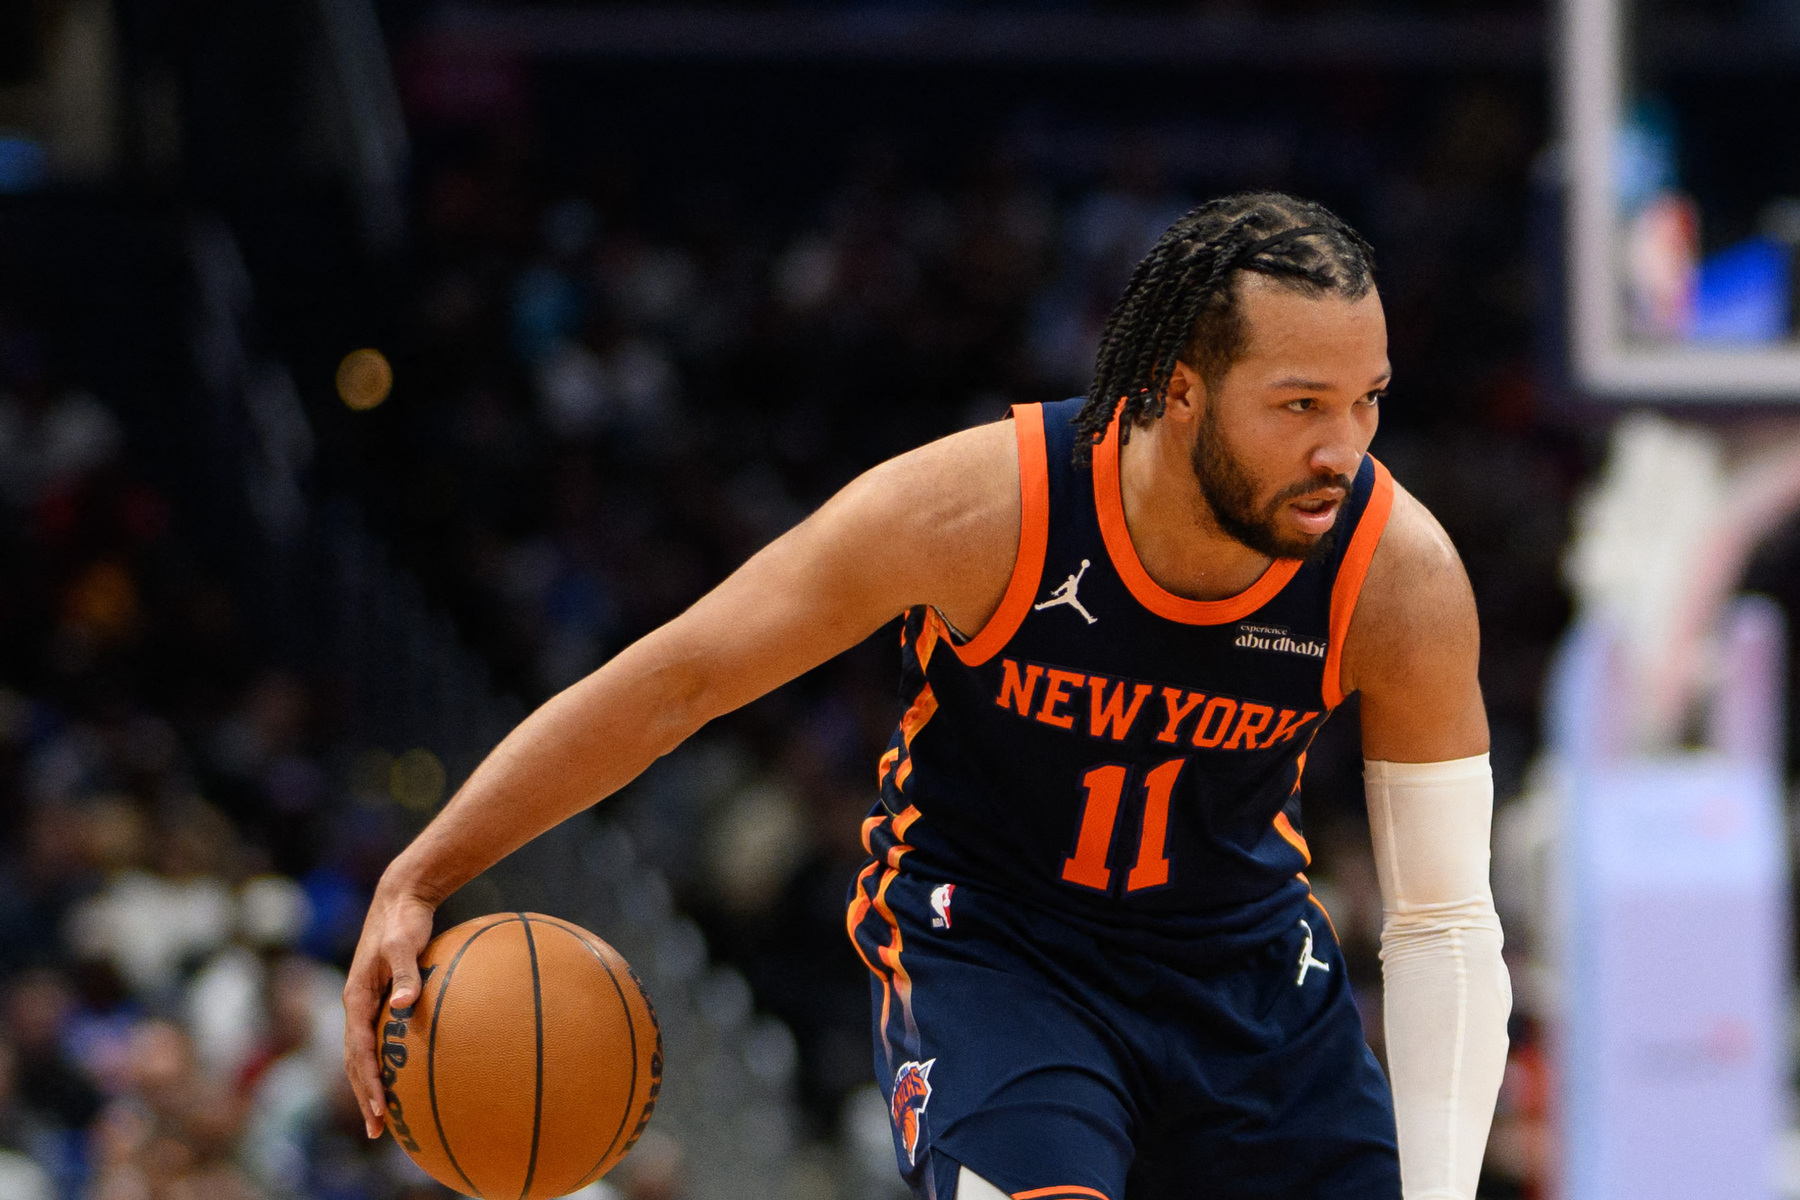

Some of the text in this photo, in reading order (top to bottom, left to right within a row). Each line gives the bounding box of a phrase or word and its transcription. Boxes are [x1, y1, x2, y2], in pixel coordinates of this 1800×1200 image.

[1235, 633, 1327, 658] abu dhabi
[1240, 624, 1288, 636] experience
[996, 658, 1320, 750] NEW YORK
[1060, 757, 1187, 893] 11
